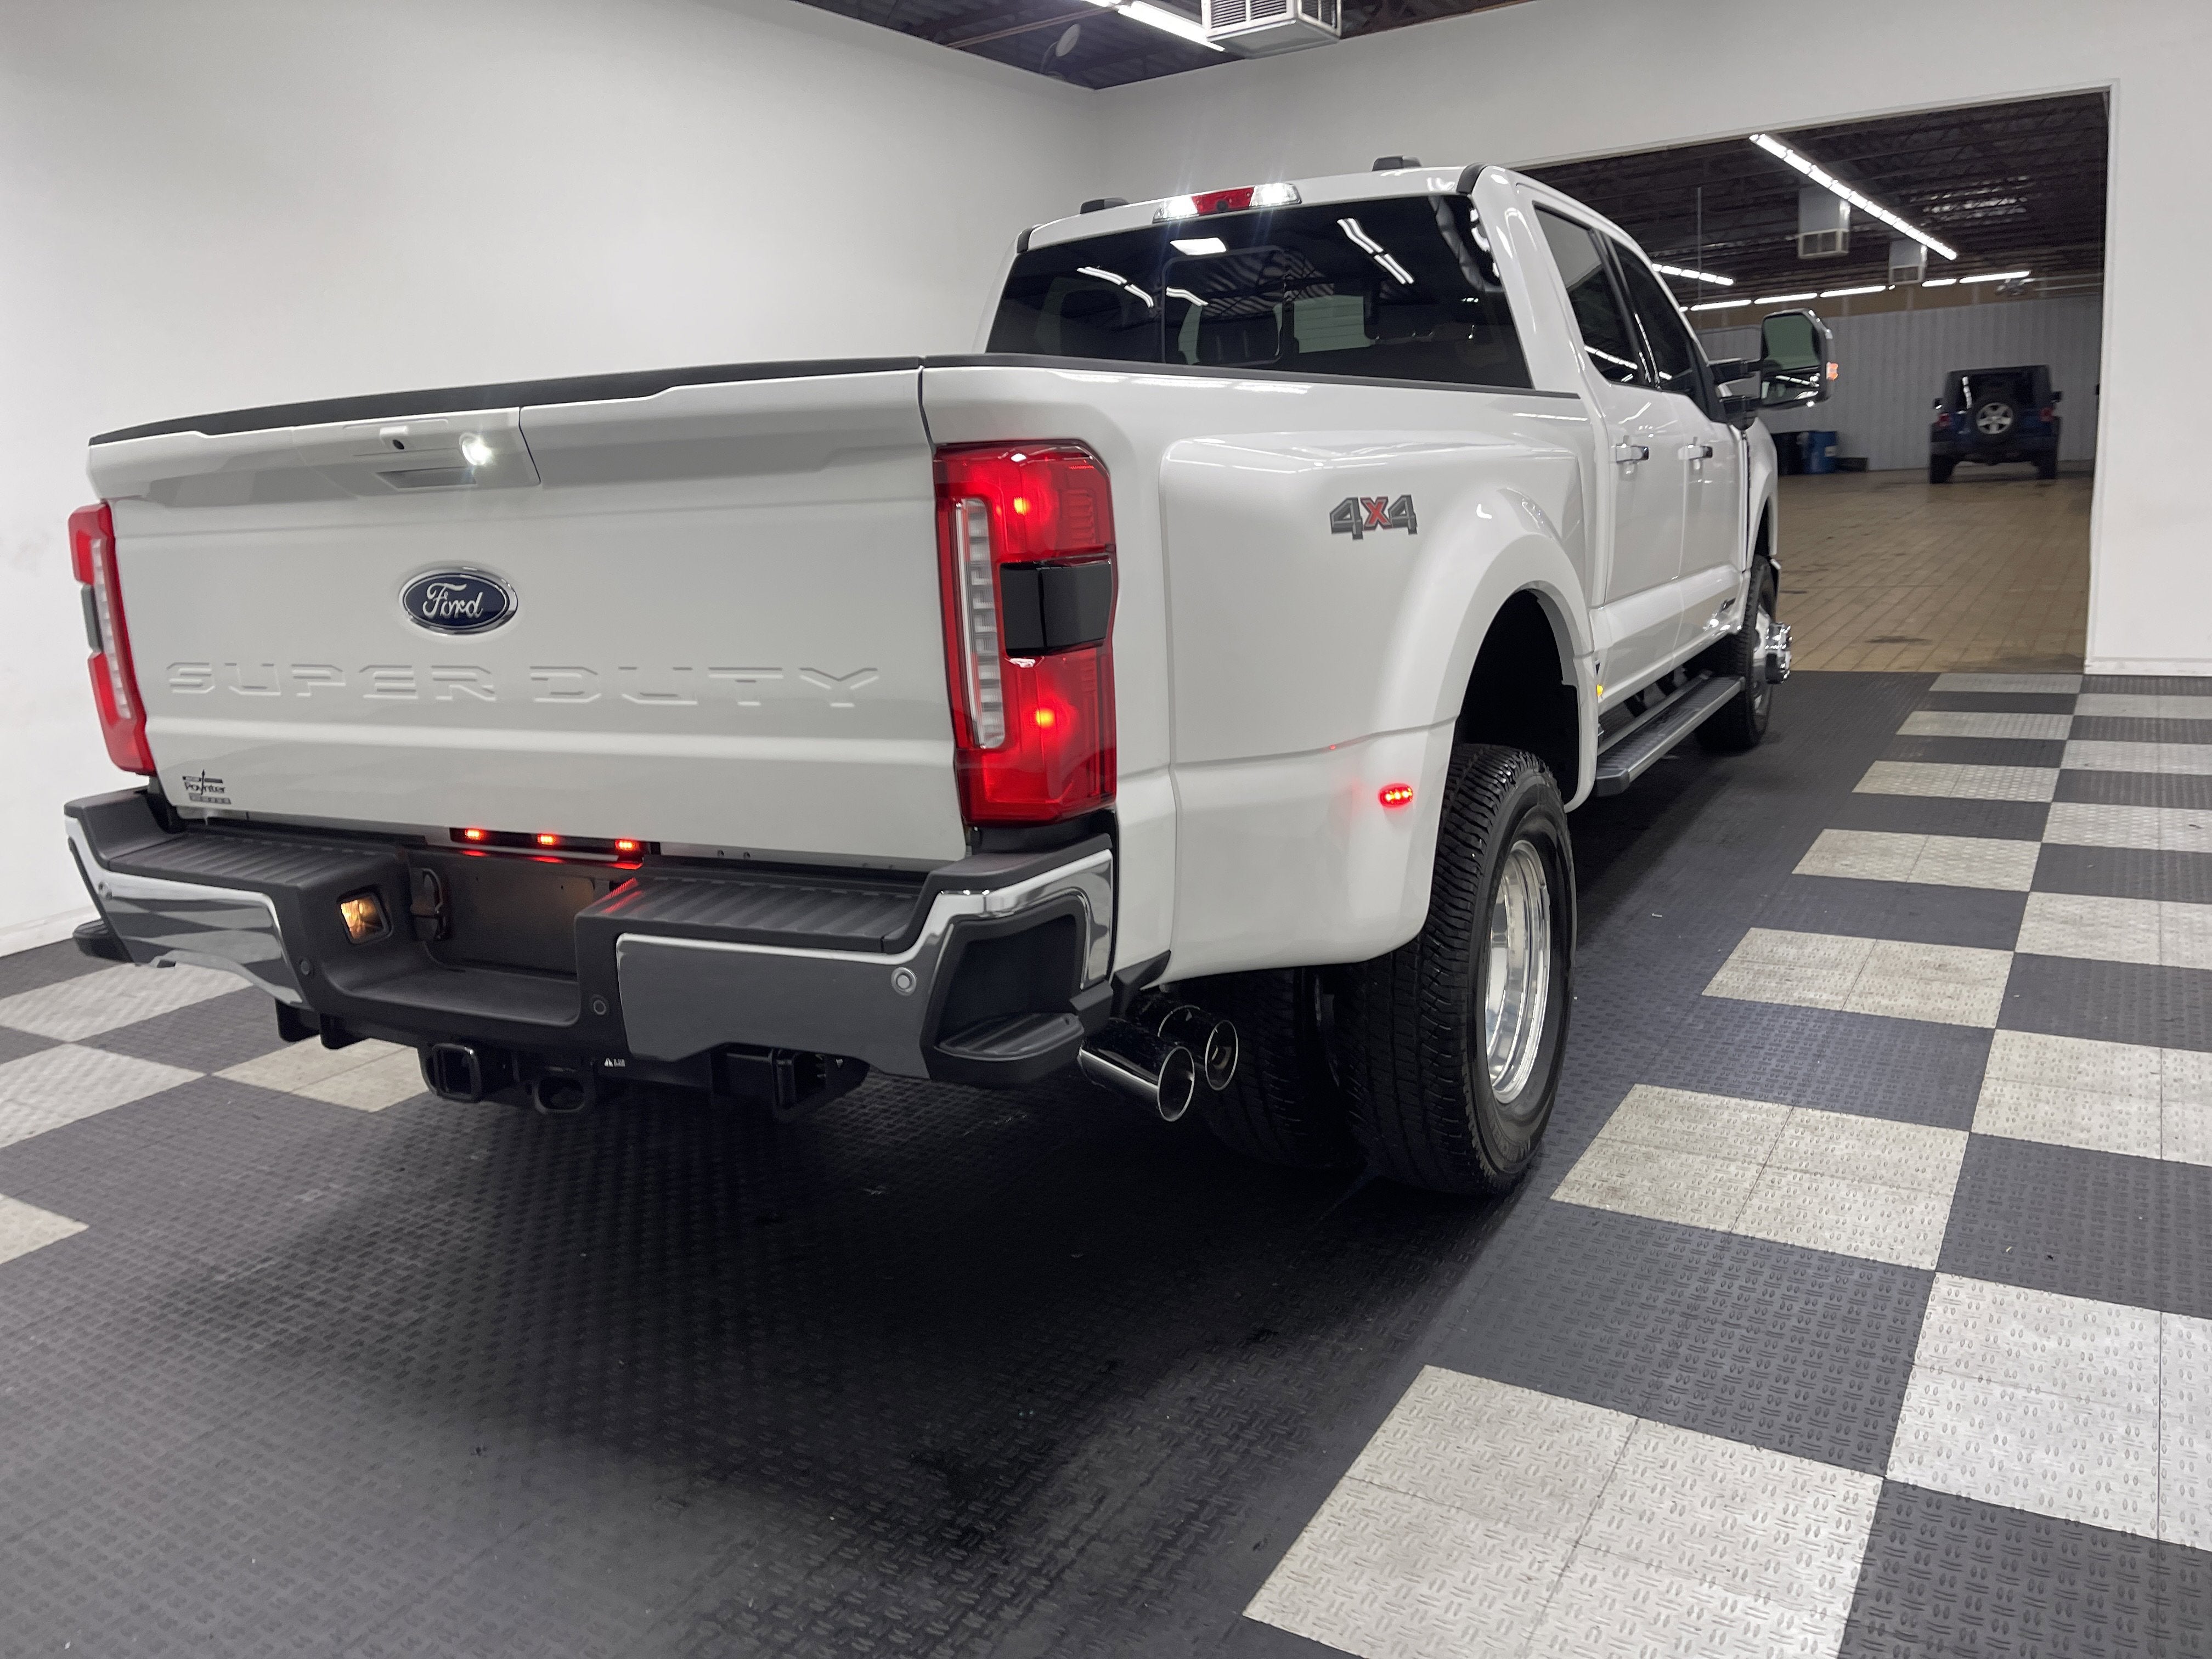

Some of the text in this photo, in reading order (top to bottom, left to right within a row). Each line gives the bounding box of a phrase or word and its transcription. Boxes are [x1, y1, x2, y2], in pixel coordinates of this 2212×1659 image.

[421, 582, 484, 619] Ford
[166, 662, 879, 708] SUPER DUTY
